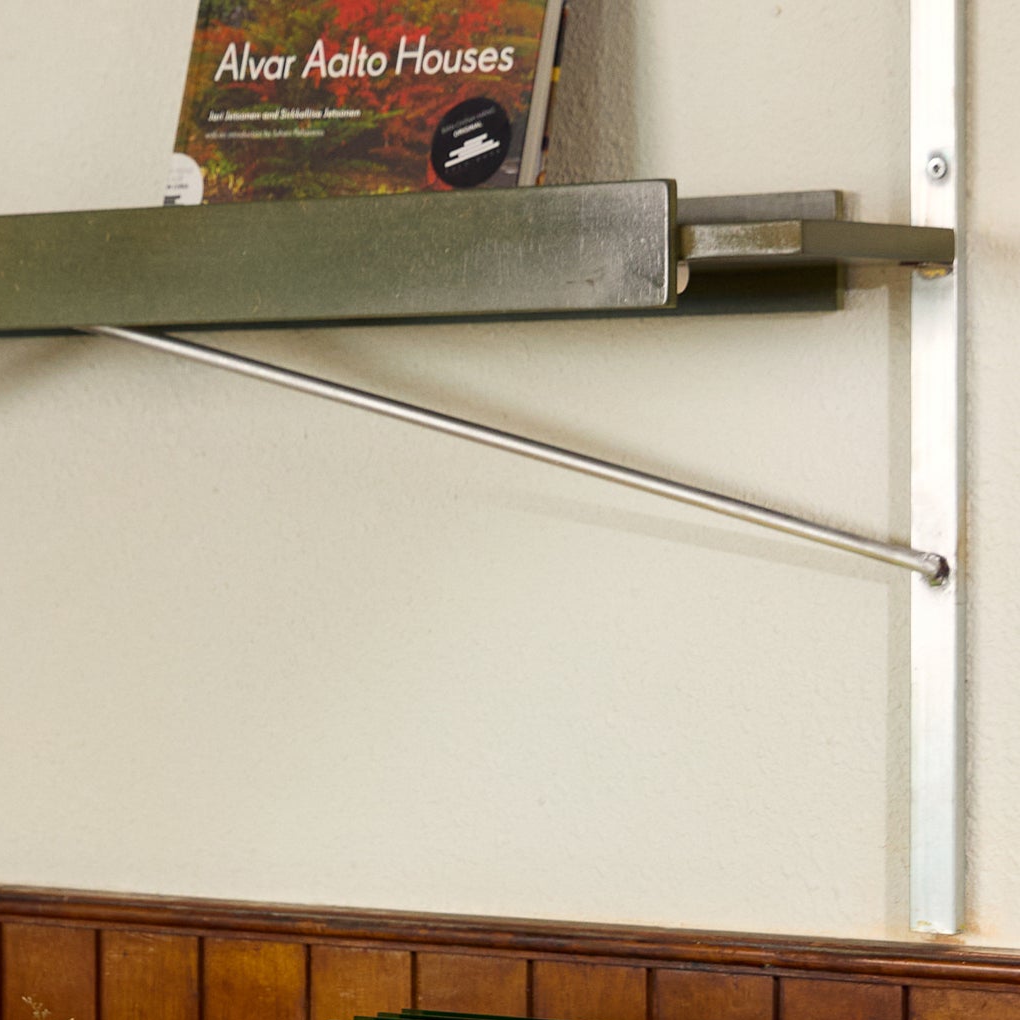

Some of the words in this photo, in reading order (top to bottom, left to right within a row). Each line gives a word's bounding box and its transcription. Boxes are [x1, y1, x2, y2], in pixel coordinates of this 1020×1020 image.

[214, 40, 296, 82] Alvar
[301, 37, 388, 80] Aalto
[395, 34, 515, 75] Houses
